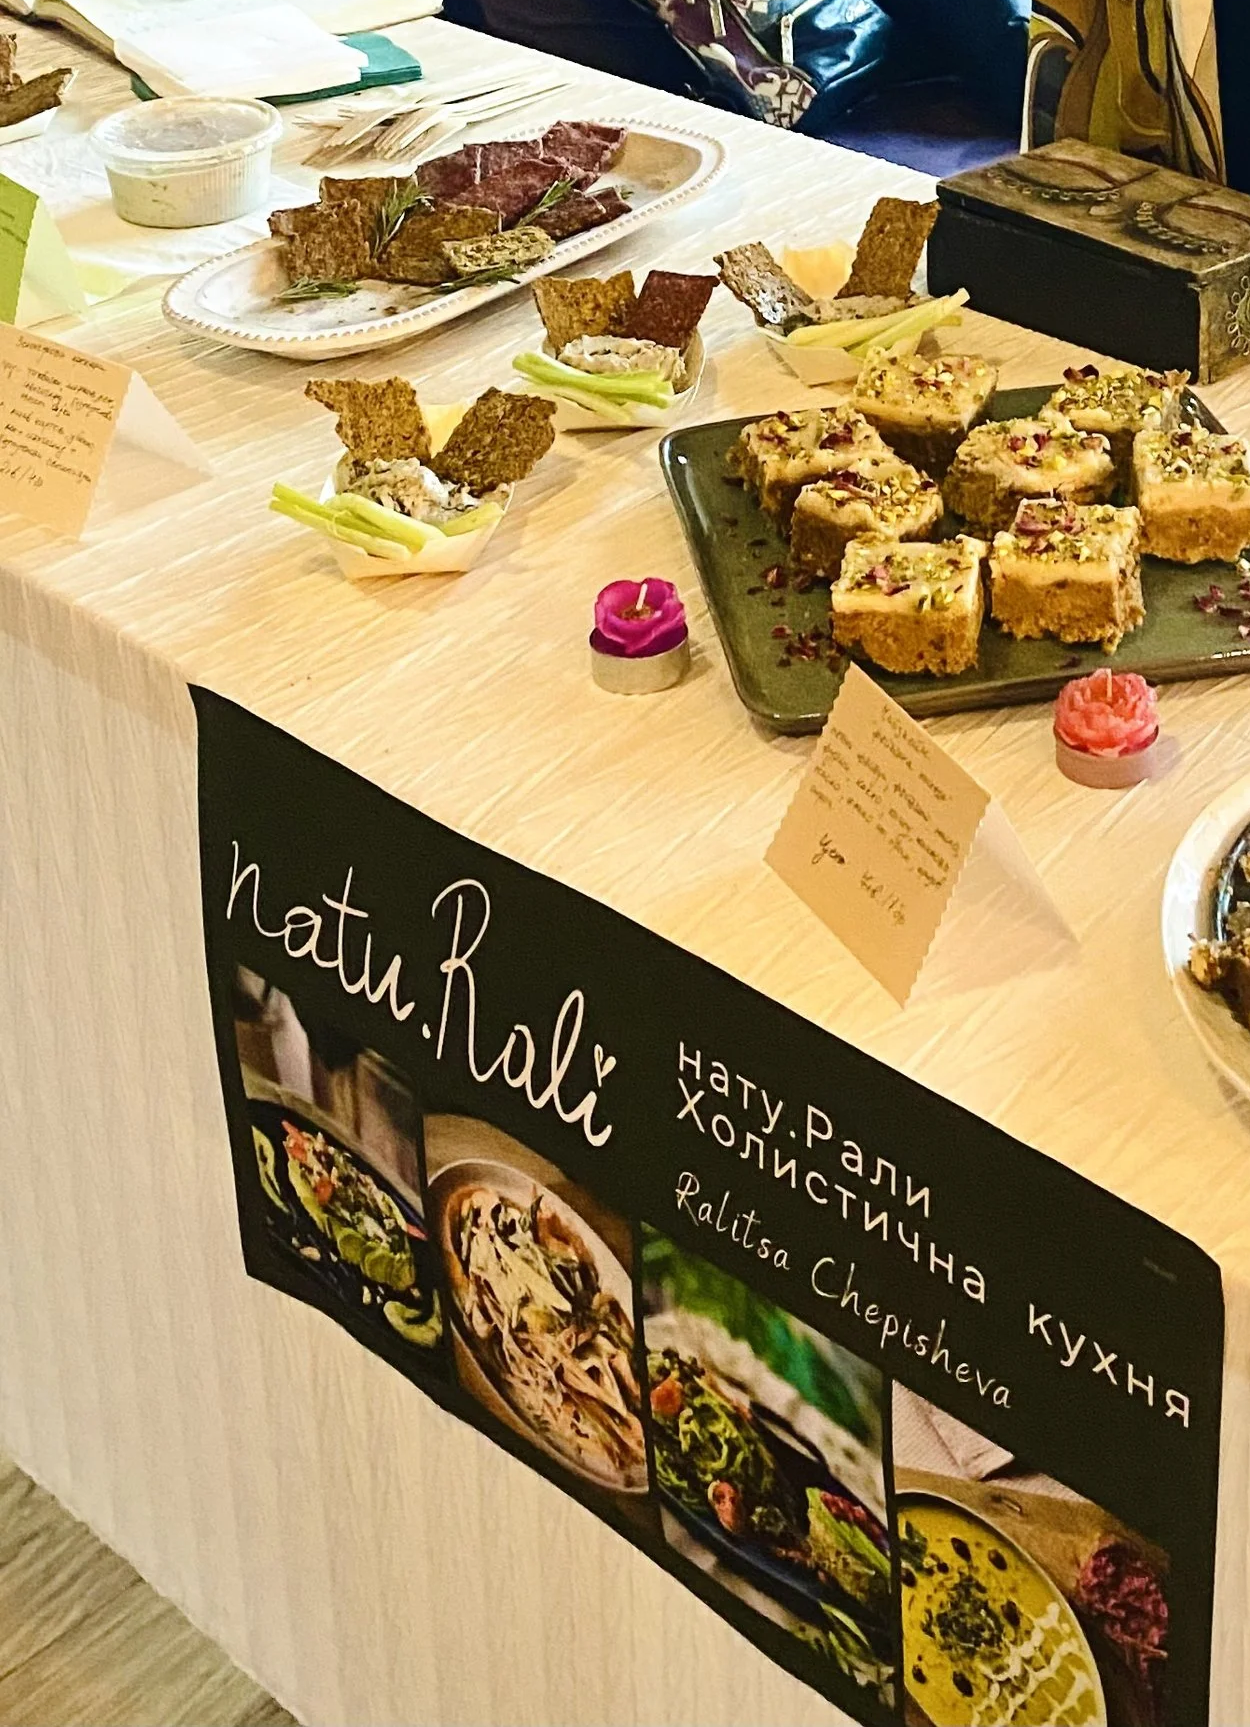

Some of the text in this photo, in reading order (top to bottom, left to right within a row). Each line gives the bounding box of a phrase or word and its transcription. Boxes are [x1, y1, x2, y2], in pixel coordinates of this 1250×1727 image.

[679, 1041, 930, 1218] нату.Рали
[675, 1171, 1011, 1410] Ralitsa Chepisheva
[676, 1077, 1190, 1428] Холистична кухня
